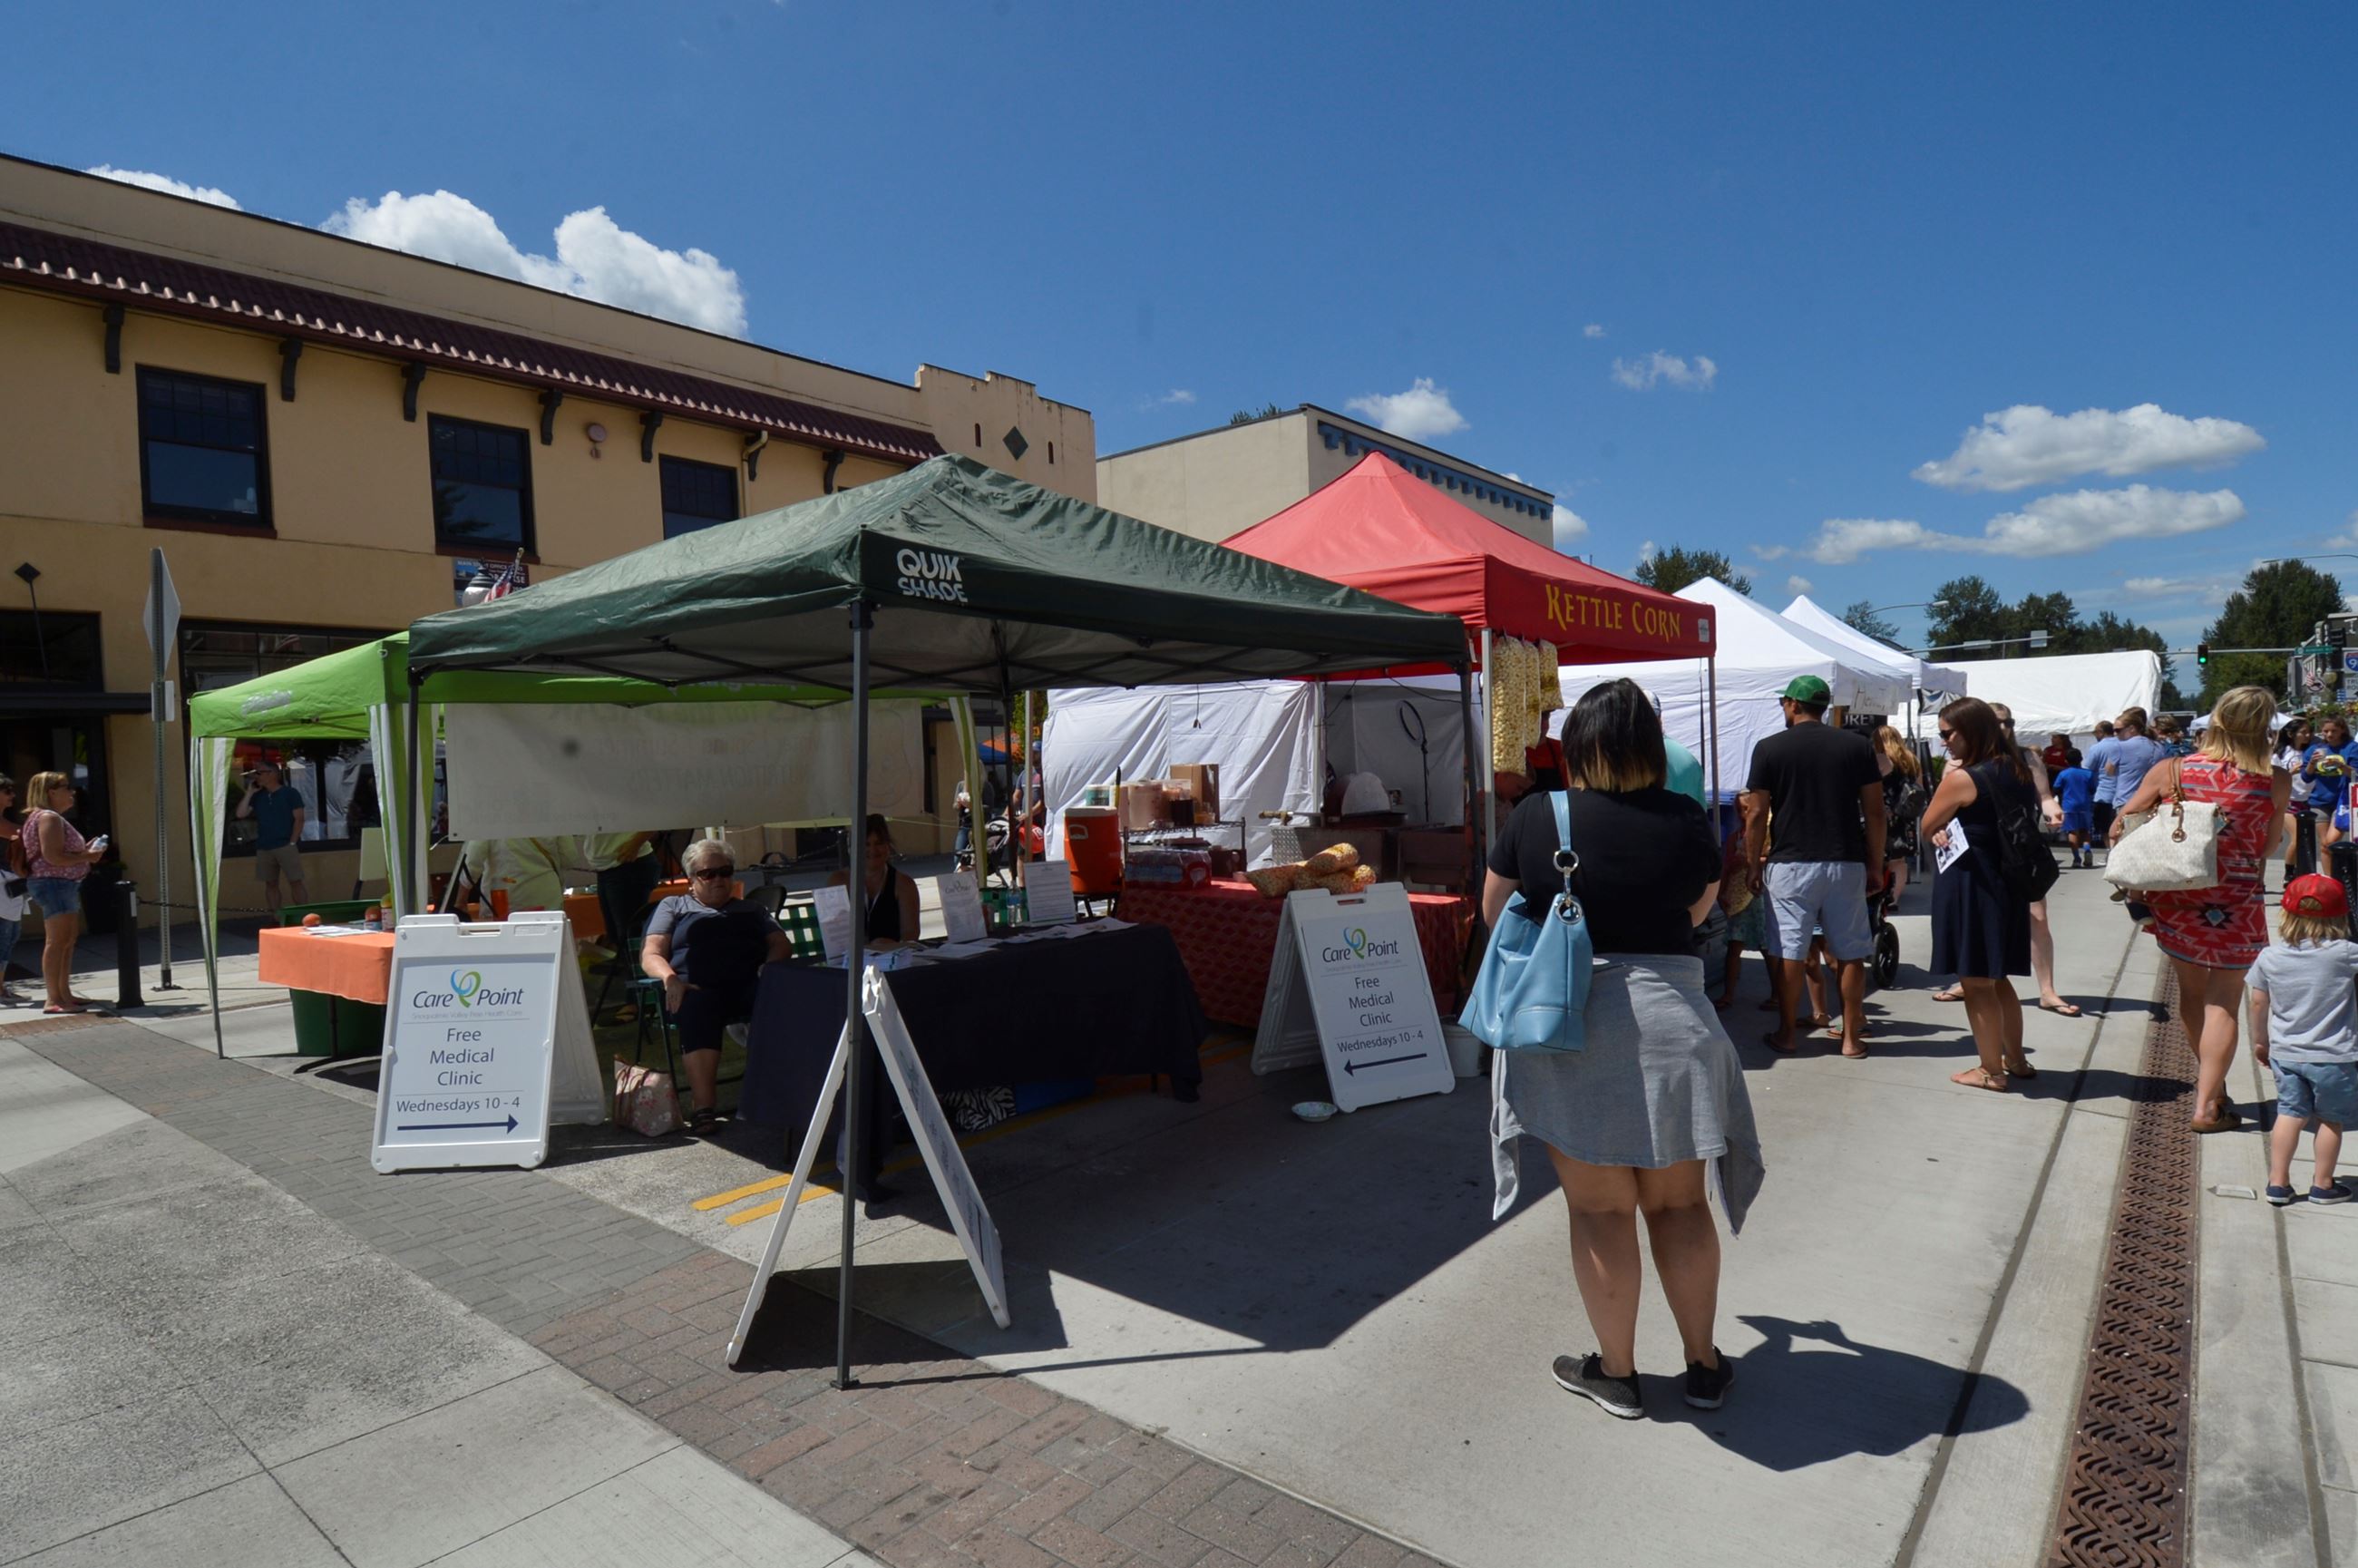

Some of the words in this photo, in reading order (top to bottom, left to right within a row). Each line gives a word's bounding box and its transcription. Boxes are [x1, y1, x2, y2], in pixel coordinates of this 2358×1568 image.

[897, 548, 962, 582] QUIK
[897, 577, 969, 603] SHADE
[1545, 583, 1623, 631] KETTLE
[1632, 601, 1681, 643] CORN
[1322, 947, 1351, 962] Care
[1368, 940, 1398, 957] Point
[1355, 976, 1380, 989] Free
[413, 990, 453, 1008] Care
[476, 988, 524, 1006] Point
[1349, 991, 1395, 1009] Medical
[1359, 1012, 1393, 1027] Clinic
[446, 1027, 482, 1043] Free
[1337, 1036, 1398, 1053] Wednesdays
[1399, 1031, 1411, 1043] 10
[1417, 1030, 1424, 1040] 4
[430, 1047, 494, 1065] Medical
[437, 1070, 482, 1086] Clinic
[396, 1097, 480, 1114] Wednesdays
[485, 1097, 500, 1109] 10
[512, 1096, 520, 1108] 4
